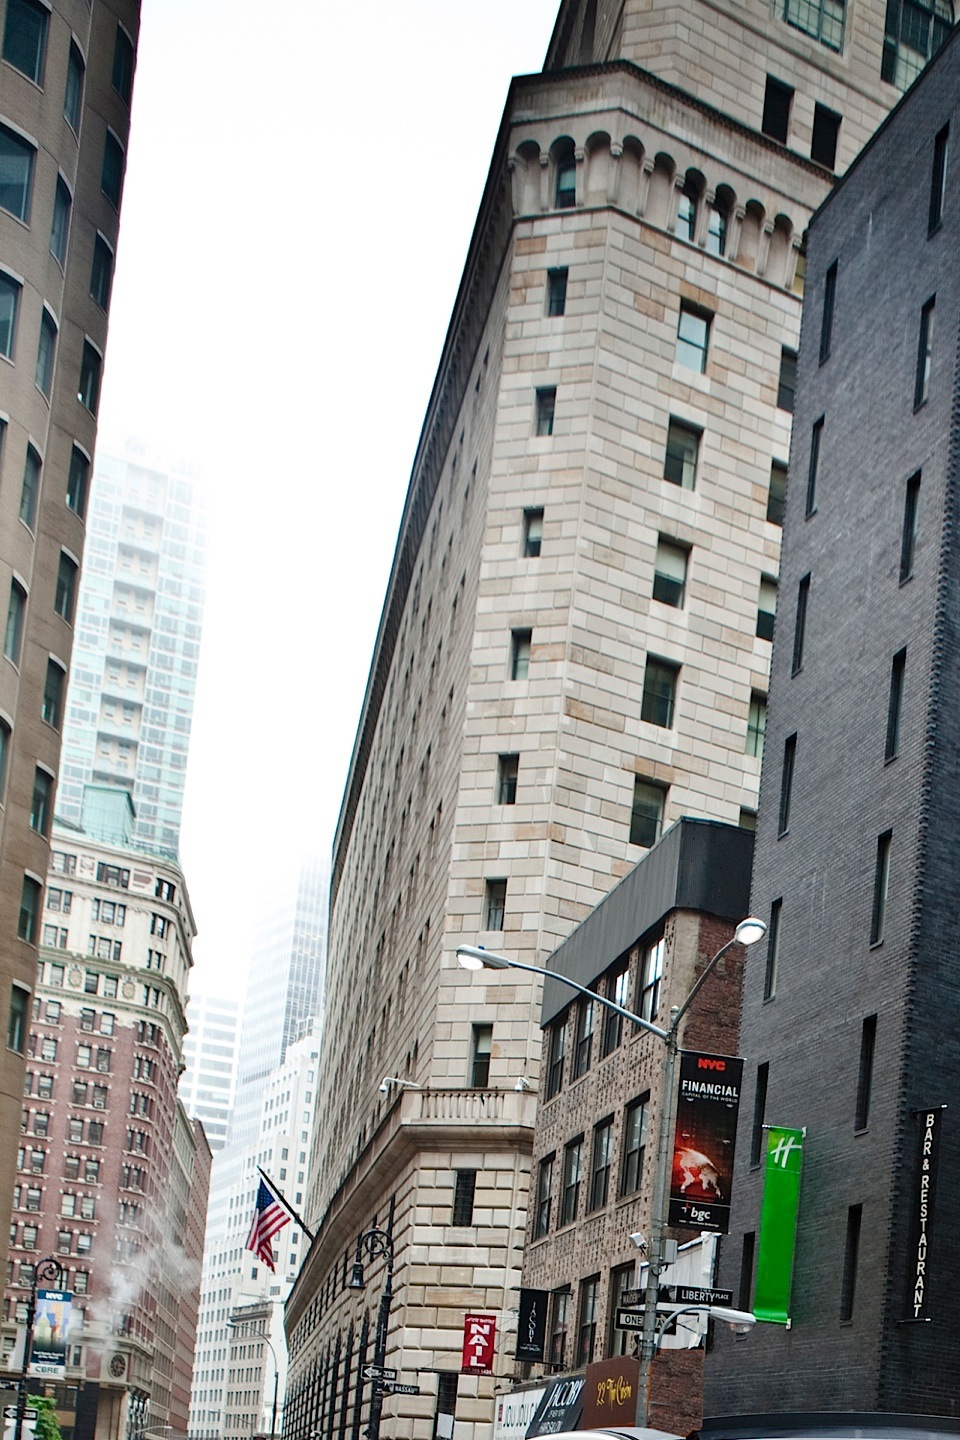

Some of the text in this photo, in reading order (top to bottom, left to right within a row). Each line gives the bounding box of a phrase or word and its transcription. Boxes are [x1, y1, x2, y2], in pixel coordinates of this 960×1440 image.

[698, 1058, 726, 1071] NYC
[681, 1080, 738, 1097] FINANCIAL
[690, 1207, 711, 1222] bgc
[913, 1114, 935, 1318] BAR & RESTAURANT
[45, 1292, 63, 1300] NYC
[681, 1290, 715, 1302] LIBERTY
[528, 1301, 537, 1343] JACOBY
[624, 1315, 643, 1325] ONE
[468, 1323, 490, 1368] NAIL
[35, 1366, 59, 1374] CBRE
[394, 1385, 415, 1394] NASSAU
[538, 1380, 586, 1421] JACOBY
